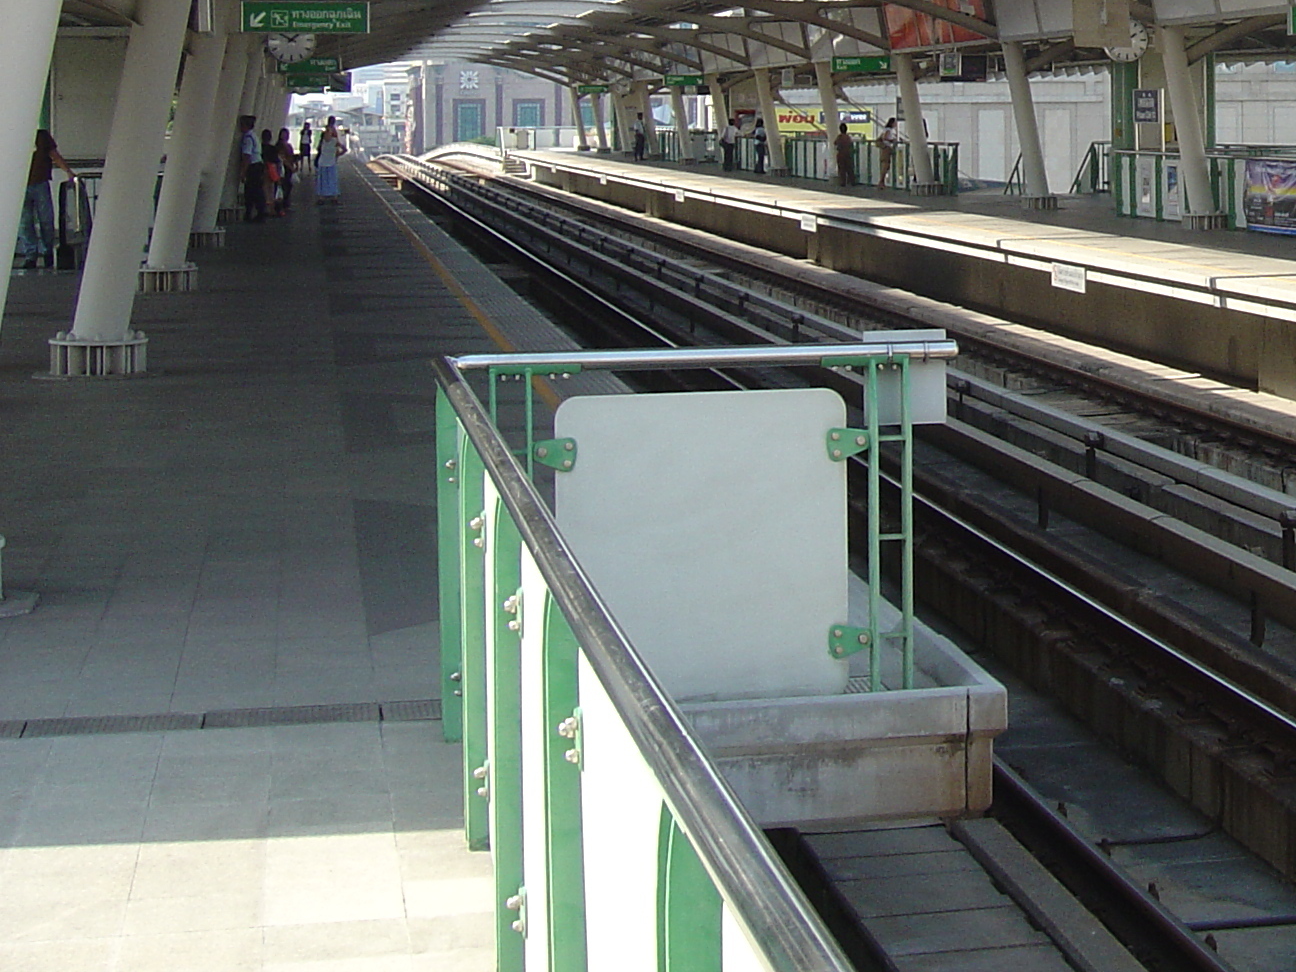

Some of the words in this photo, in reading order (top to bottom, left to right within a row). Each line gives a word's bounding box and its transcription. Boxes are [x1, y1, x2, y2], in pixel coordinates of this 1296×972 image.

[291, 7, 362, 22] ทางออกฉุกเฉิน
[292, 21, 333, 29] Emergency
